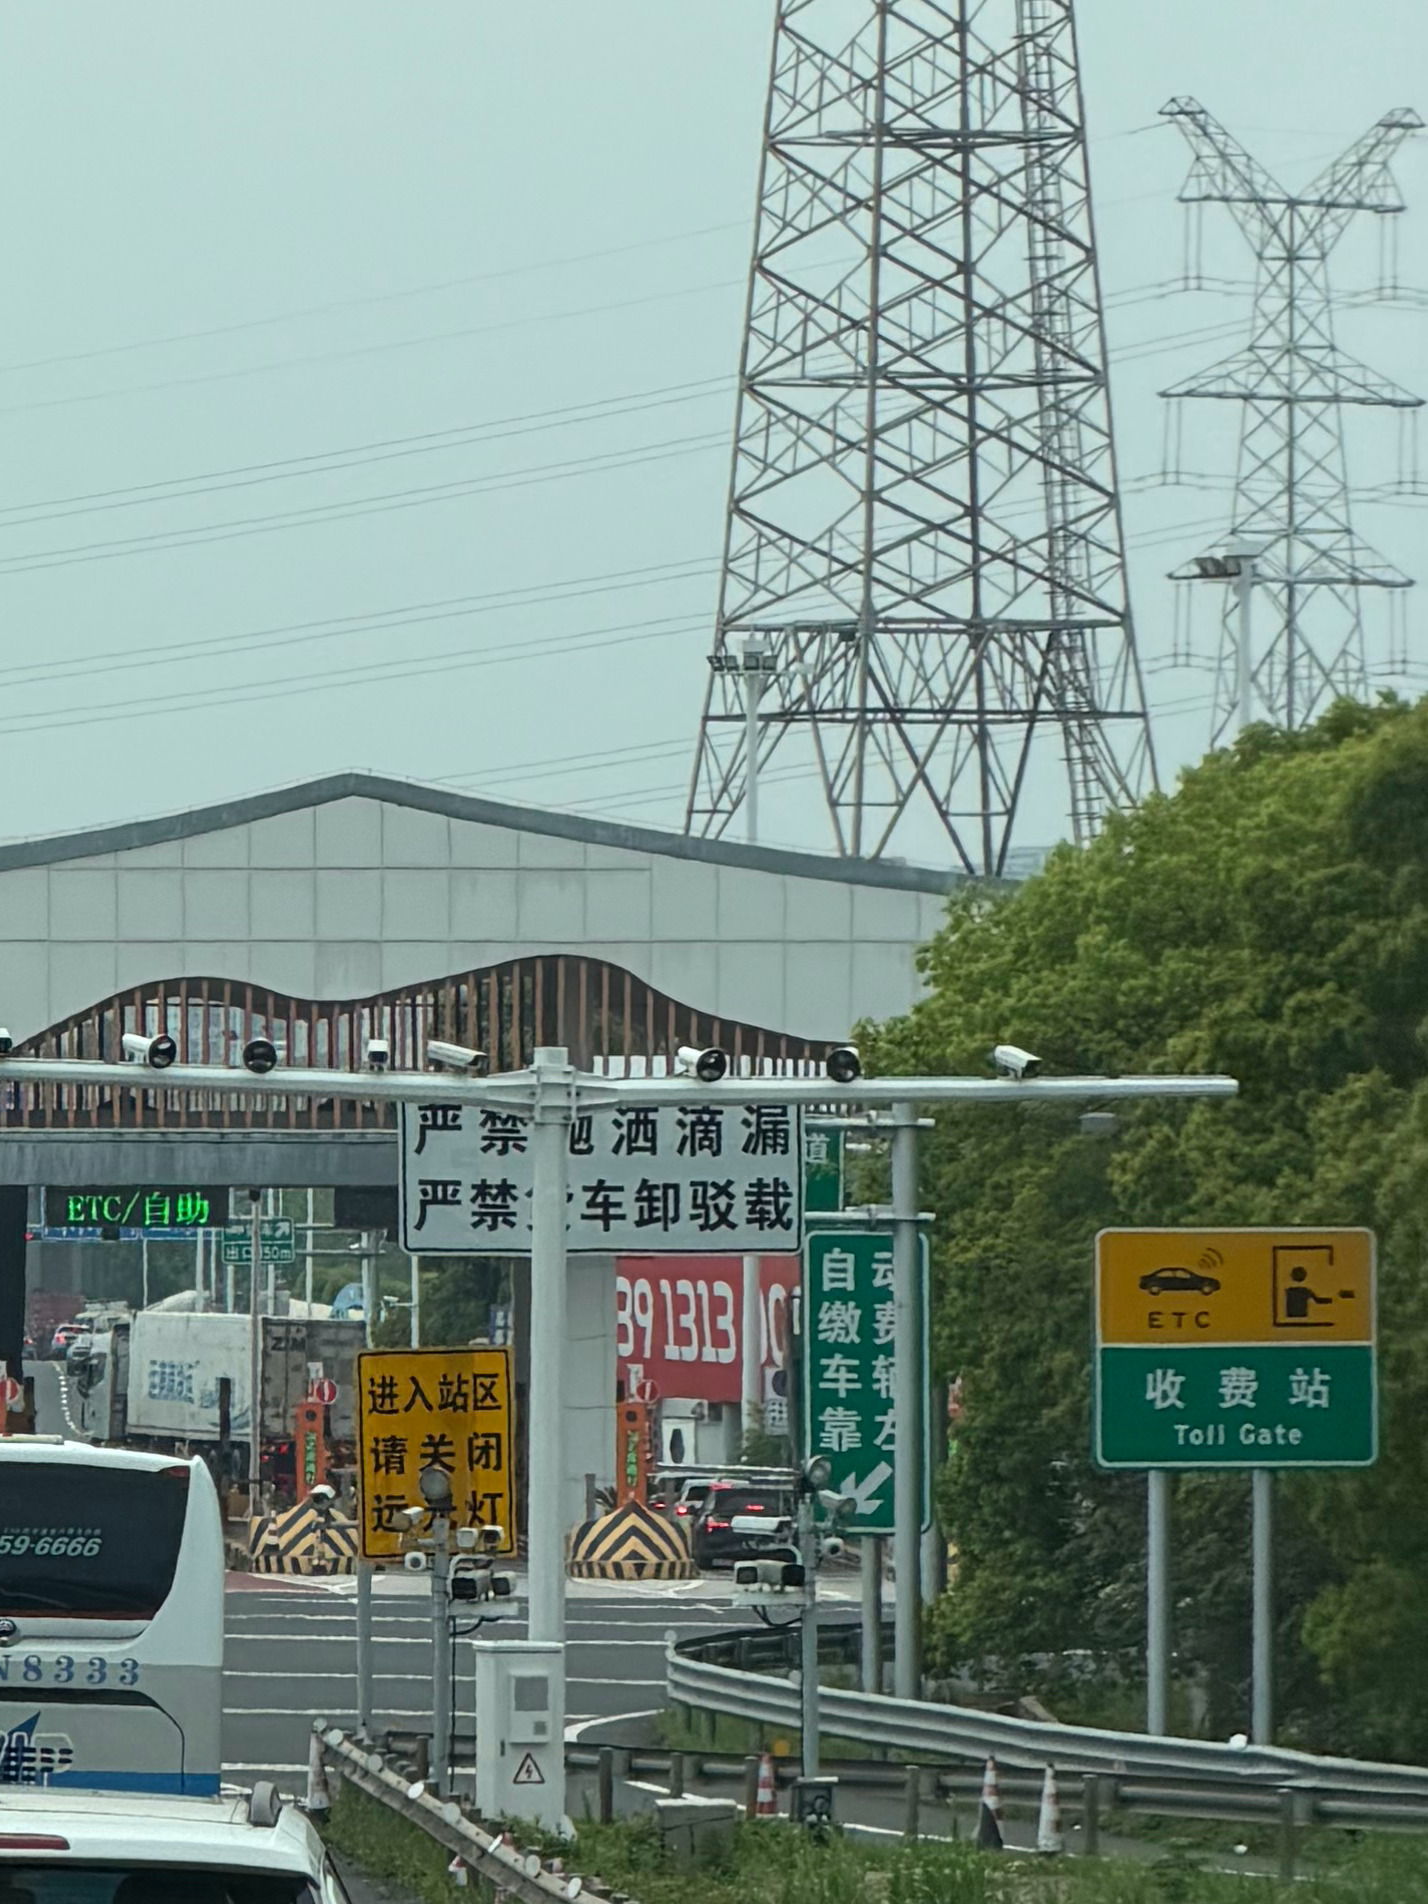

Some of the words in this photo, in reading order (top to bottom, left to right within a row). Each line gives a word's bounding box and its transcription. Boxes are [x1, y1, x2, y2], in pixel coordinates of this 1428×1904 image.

[67, 1190, 211, 1226] ETC/自助
[413, 1177, 793, 1233] 严禁车卸驳载
[1148, 1311, 1211, 1329] ETC
[368, 1372, 502, 1415] 进入站区
[1145, 1365, 1332, 1410] 收费站
[370, 1431, 502, 1475] 请关闭
[1174, 1423, 1225, 1446] Toll
[1239, 1423, 1303, 1446] Gate
